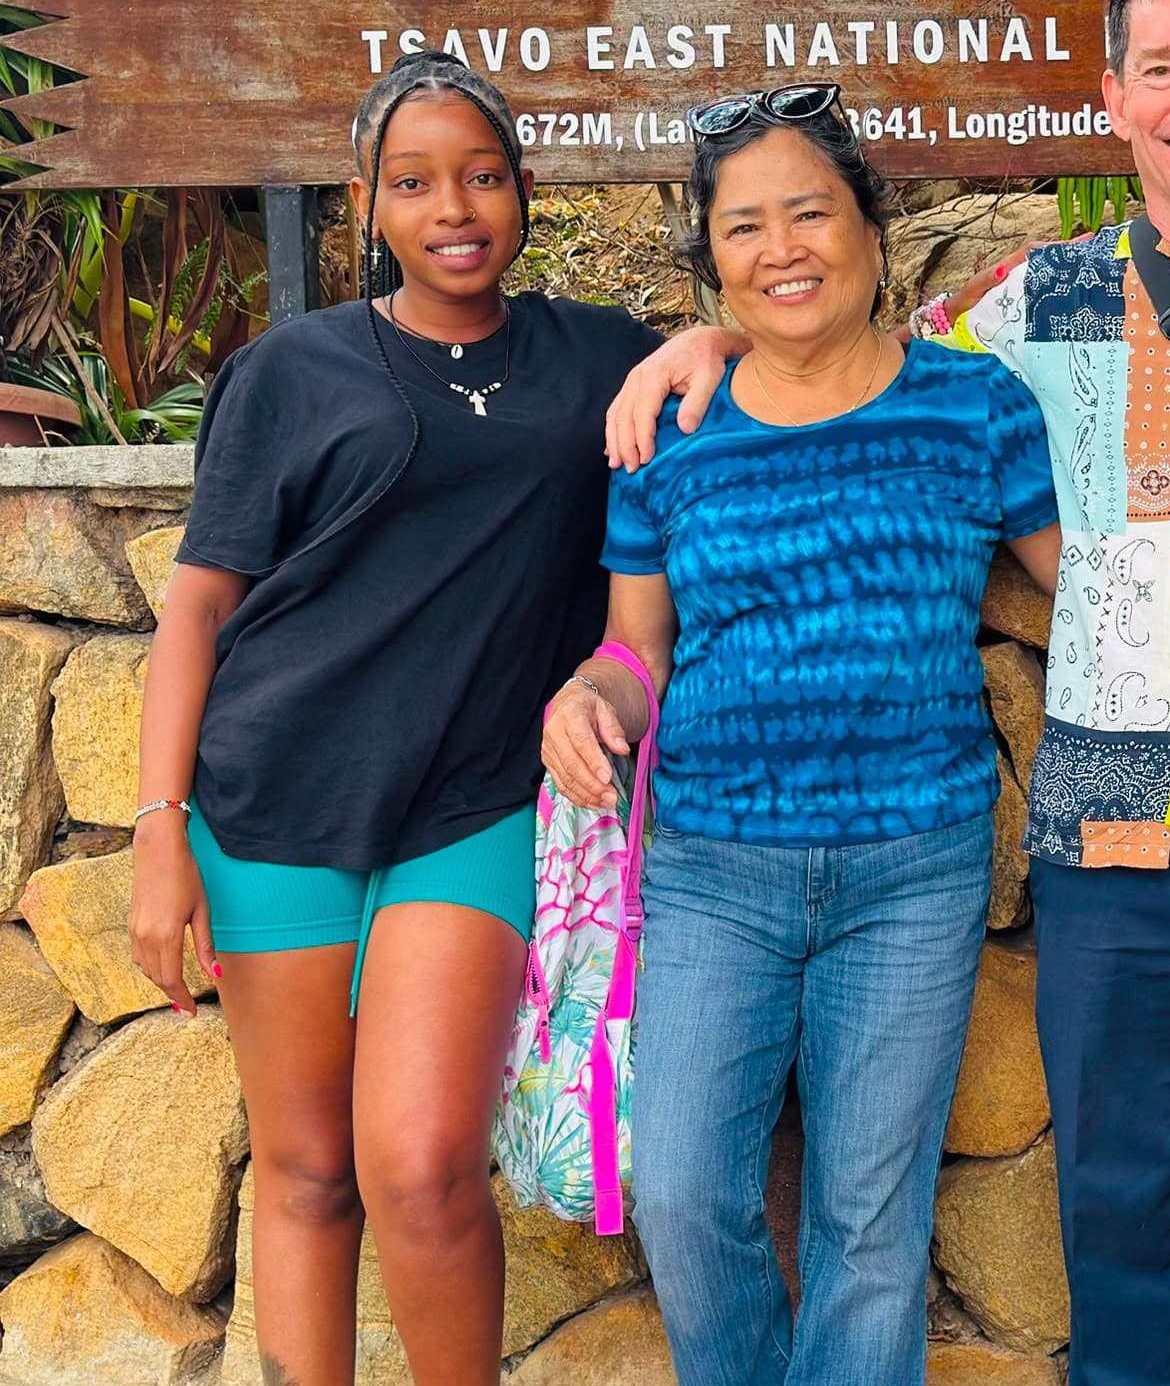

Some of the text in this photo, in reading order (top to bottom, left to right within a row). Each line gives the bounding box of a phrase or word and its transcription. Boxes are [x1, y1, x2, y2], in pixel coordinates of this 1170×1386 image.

[361, 27, 551, 73] TSAVO
[586, 24, 732, 70] EAST
[765, 17, 1070, 67] NATIONAL
[515, 112, 624, 152] 672M,
[948, 103, 1113, 145] Longitude
